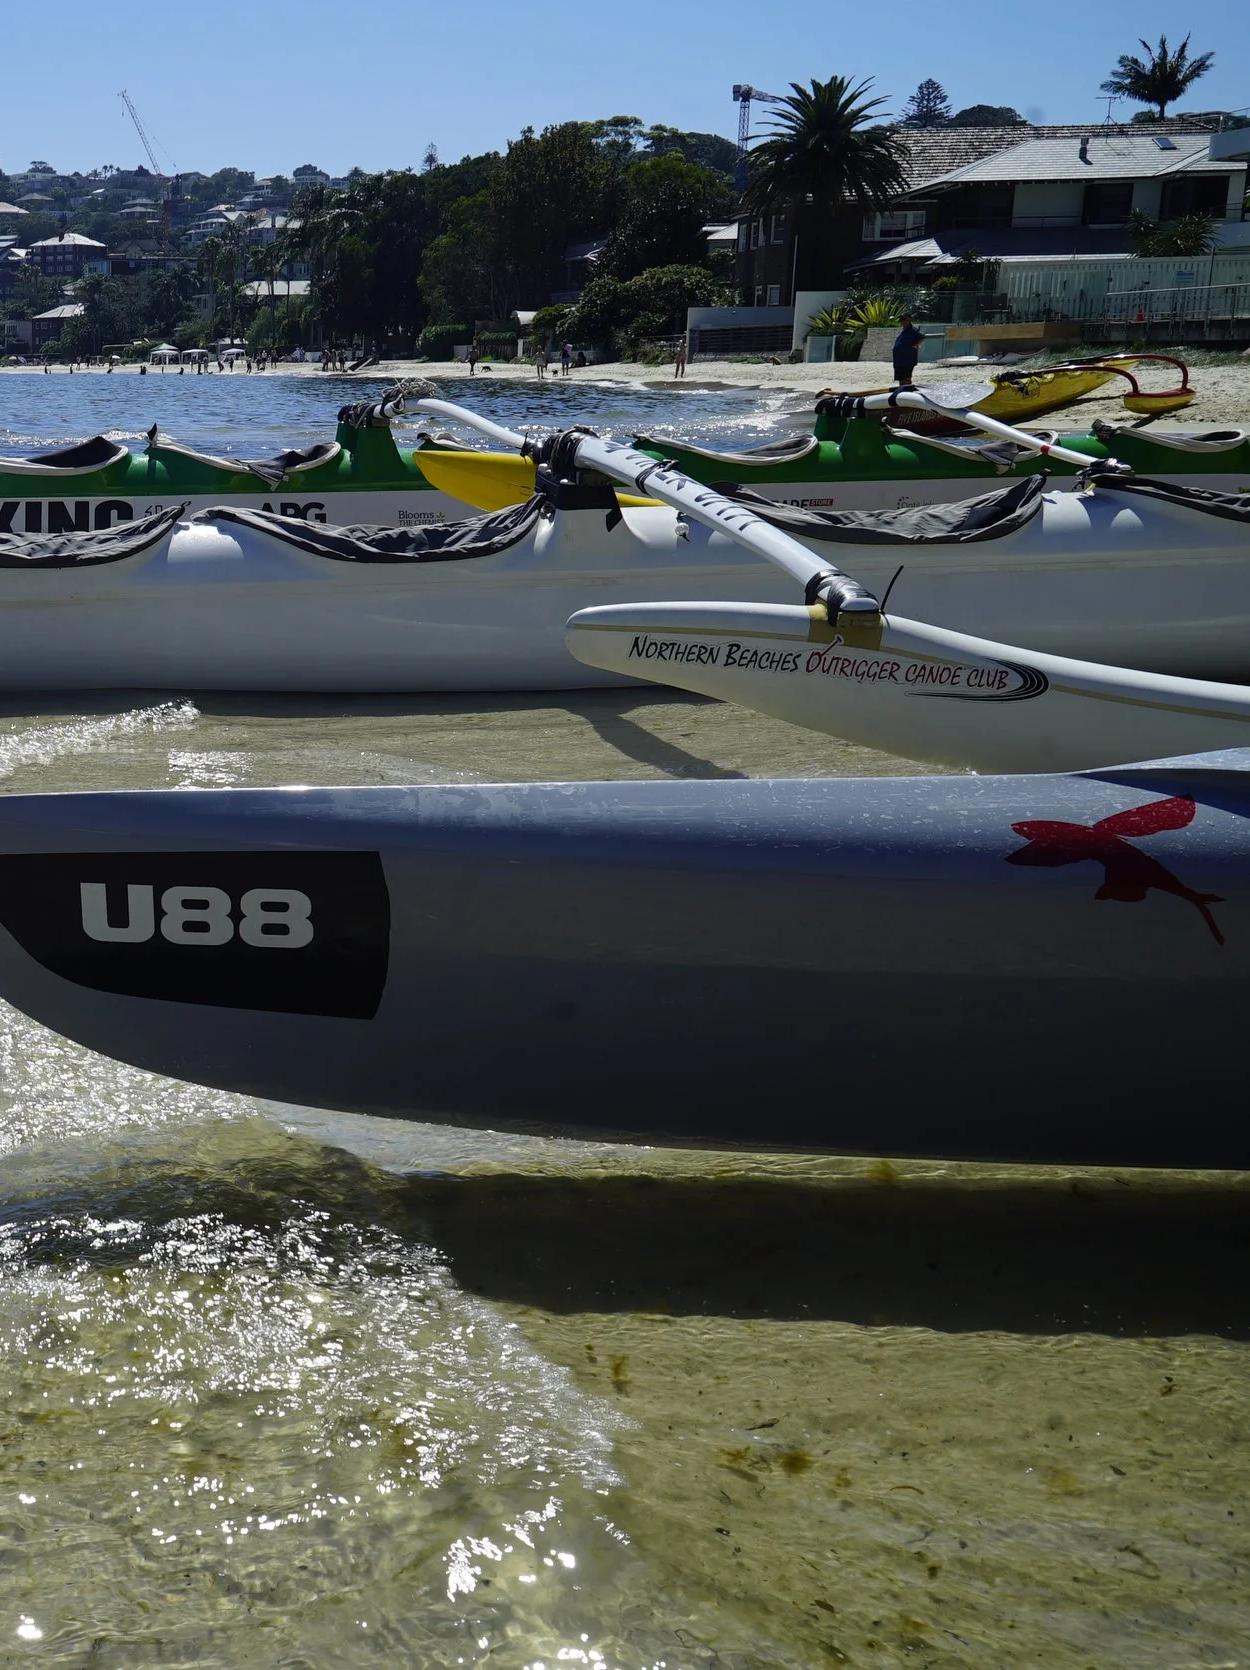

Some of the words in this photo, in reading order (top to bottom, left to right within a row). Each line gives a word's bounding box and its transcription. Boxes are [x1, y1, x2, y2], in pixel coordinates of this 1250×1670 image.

[398, 510, 435, 519] Blooms
[629, 635, 719, 665] NORTHERN
[723, 643, 800, 673] BEACHES
[805, 648, 900, 682] OUTRIGGER
[904, 664, 963, 686] CANOE
[966, 667, 1010, 690] CLUB
[80, 882, 314, 948] U88
